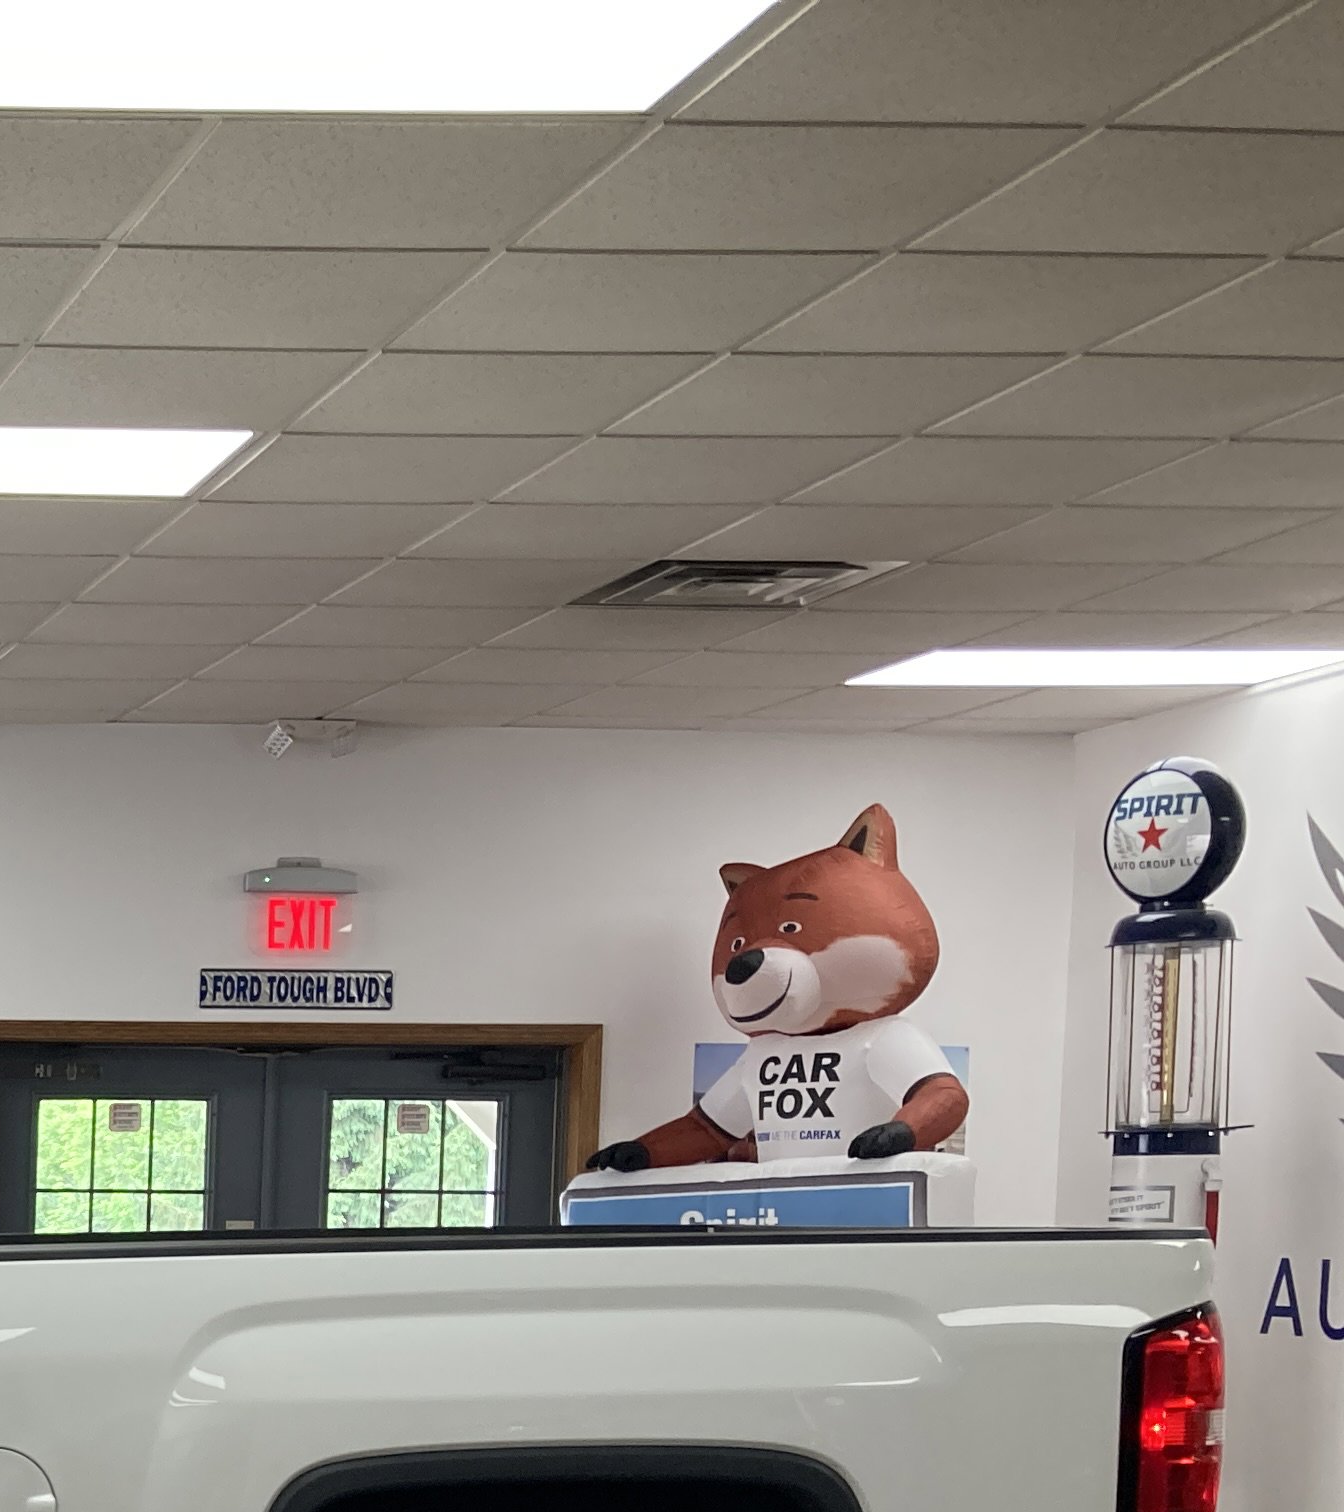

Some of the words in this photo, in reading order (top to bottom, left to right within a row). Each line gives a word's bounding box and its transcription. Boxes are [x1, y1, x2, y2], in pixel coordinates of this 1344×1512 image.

[1114, 792, 1204, 821] SPIRIT
[1113, 860, 1136, 871] AUTO
[1138, 858, 1176, 870] GROUP
[267, 898, 337, 951] EXIT
[212, 974, 262, 1003] FORD
[267, 975, 329, 1004] TOUGH
[333, 976, 380, 1004] BLVD
[758, 1052, 841, 1086] CAR
[758, 1087, 837, 1121] FOX
[799, 1129, 842, 1141] CARFAX
